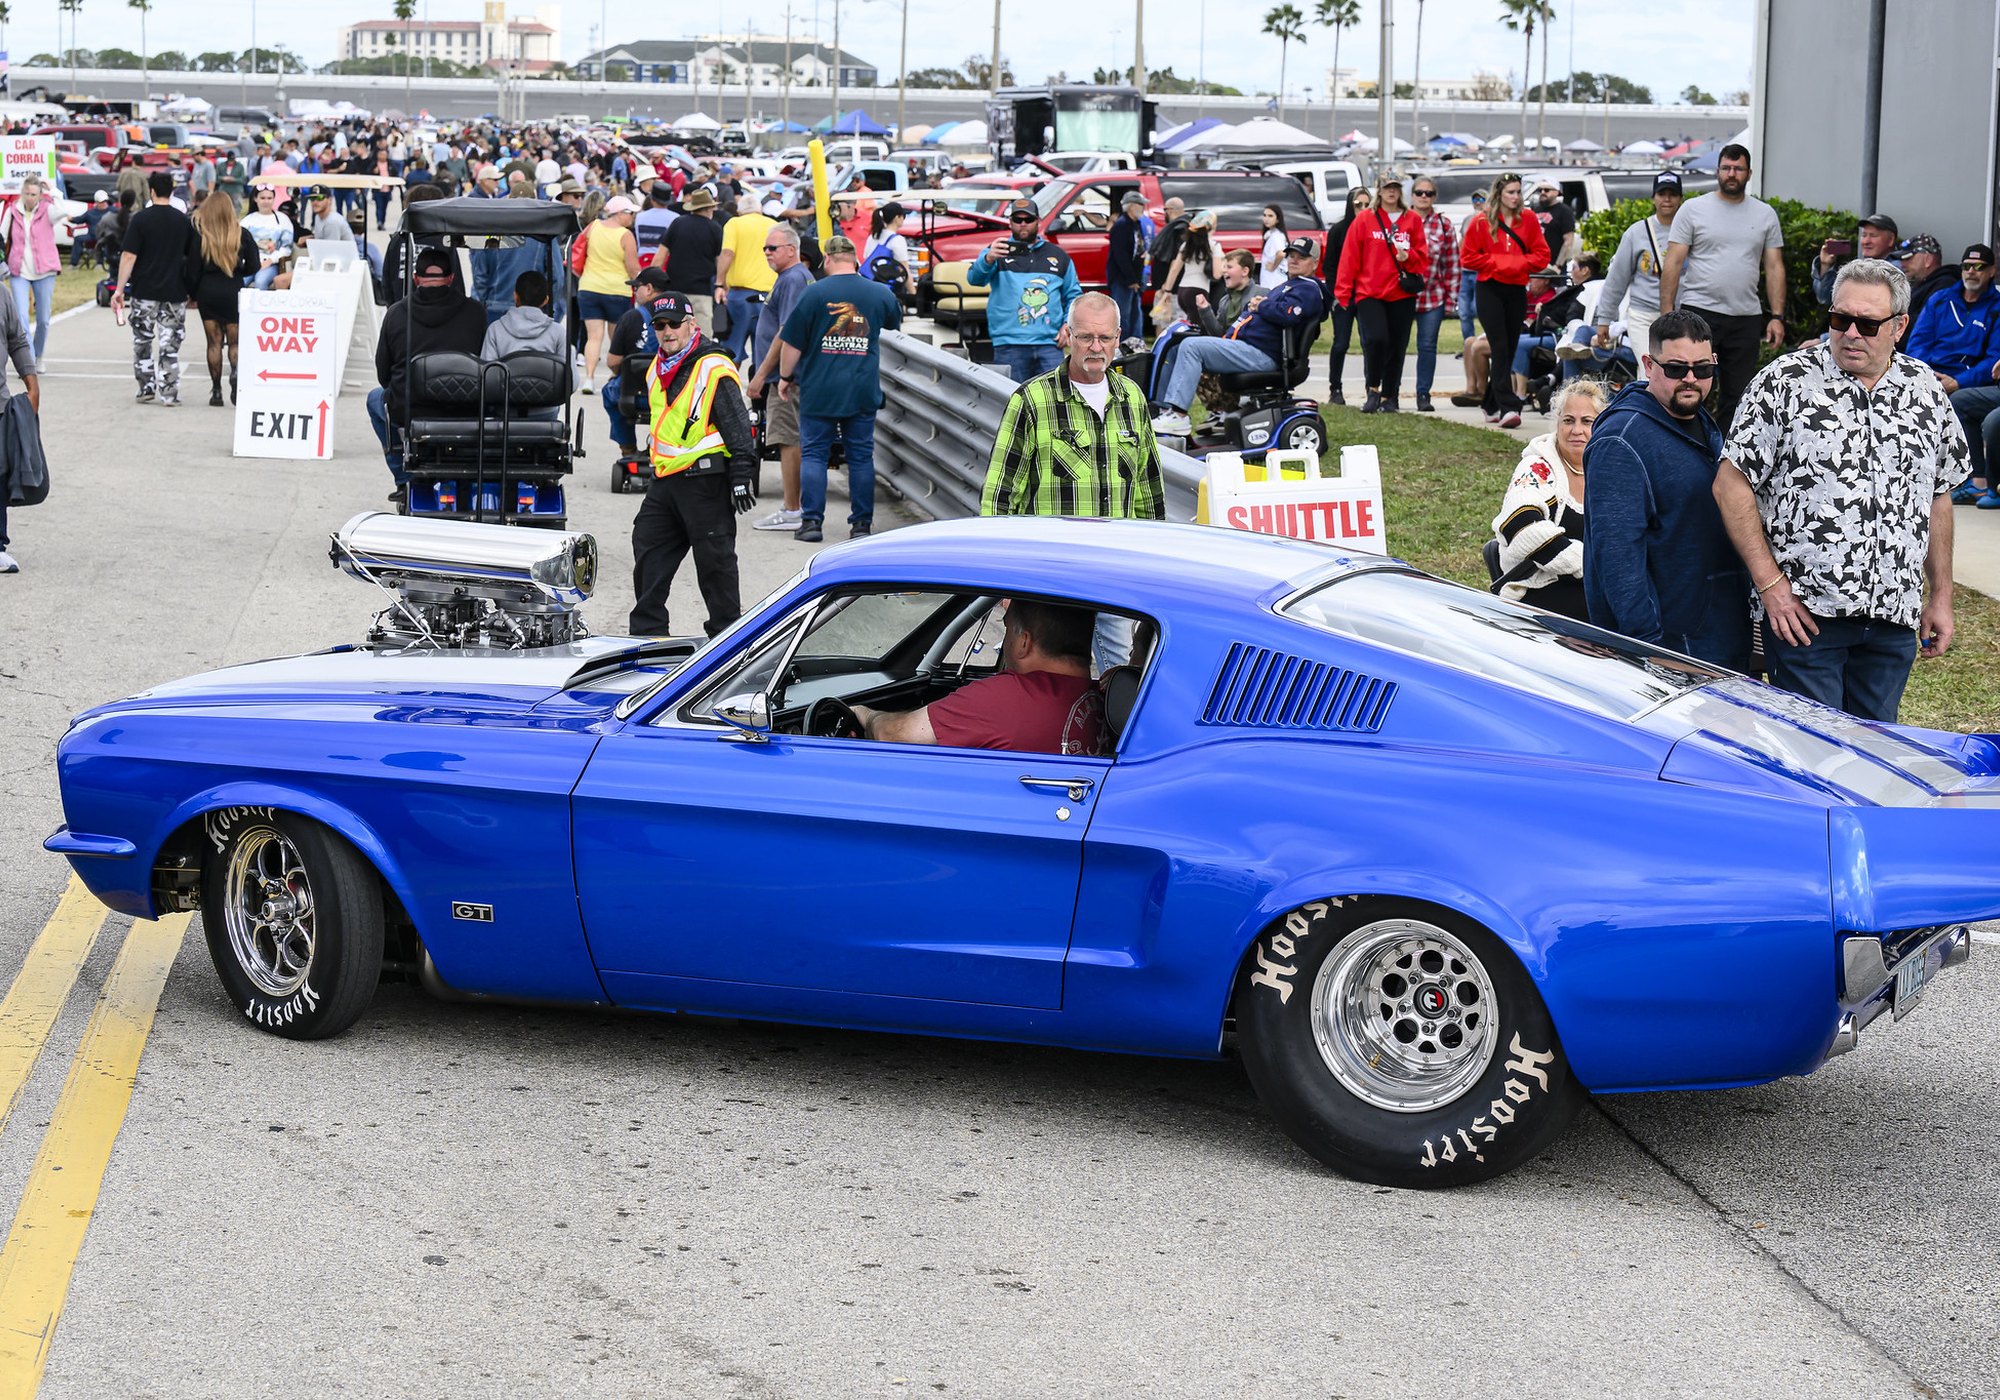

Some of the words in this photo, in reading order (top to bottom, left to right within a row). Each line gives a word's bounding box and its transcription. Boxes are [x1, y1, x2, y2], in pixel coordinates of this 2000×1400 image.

[15, 139, 35, 150] CAR
[6, 153, 44, 164] CORRAL
[260, 317, 315, 334] ONE
[256, 335, 319, 353] WAY
[821, 335, 869, 344] ALLIGATOR
[821, 341, 869, 350] ALCATRAZ
[250, 411, 313, 440] EXIT
[1227, 500, 1375, 540] SHUTTLE
[455, 905, 490, 919] GT
[245, 978, 320, 1027] Hoosier
[1420, 1030, 1555, 1168] Hoosier
